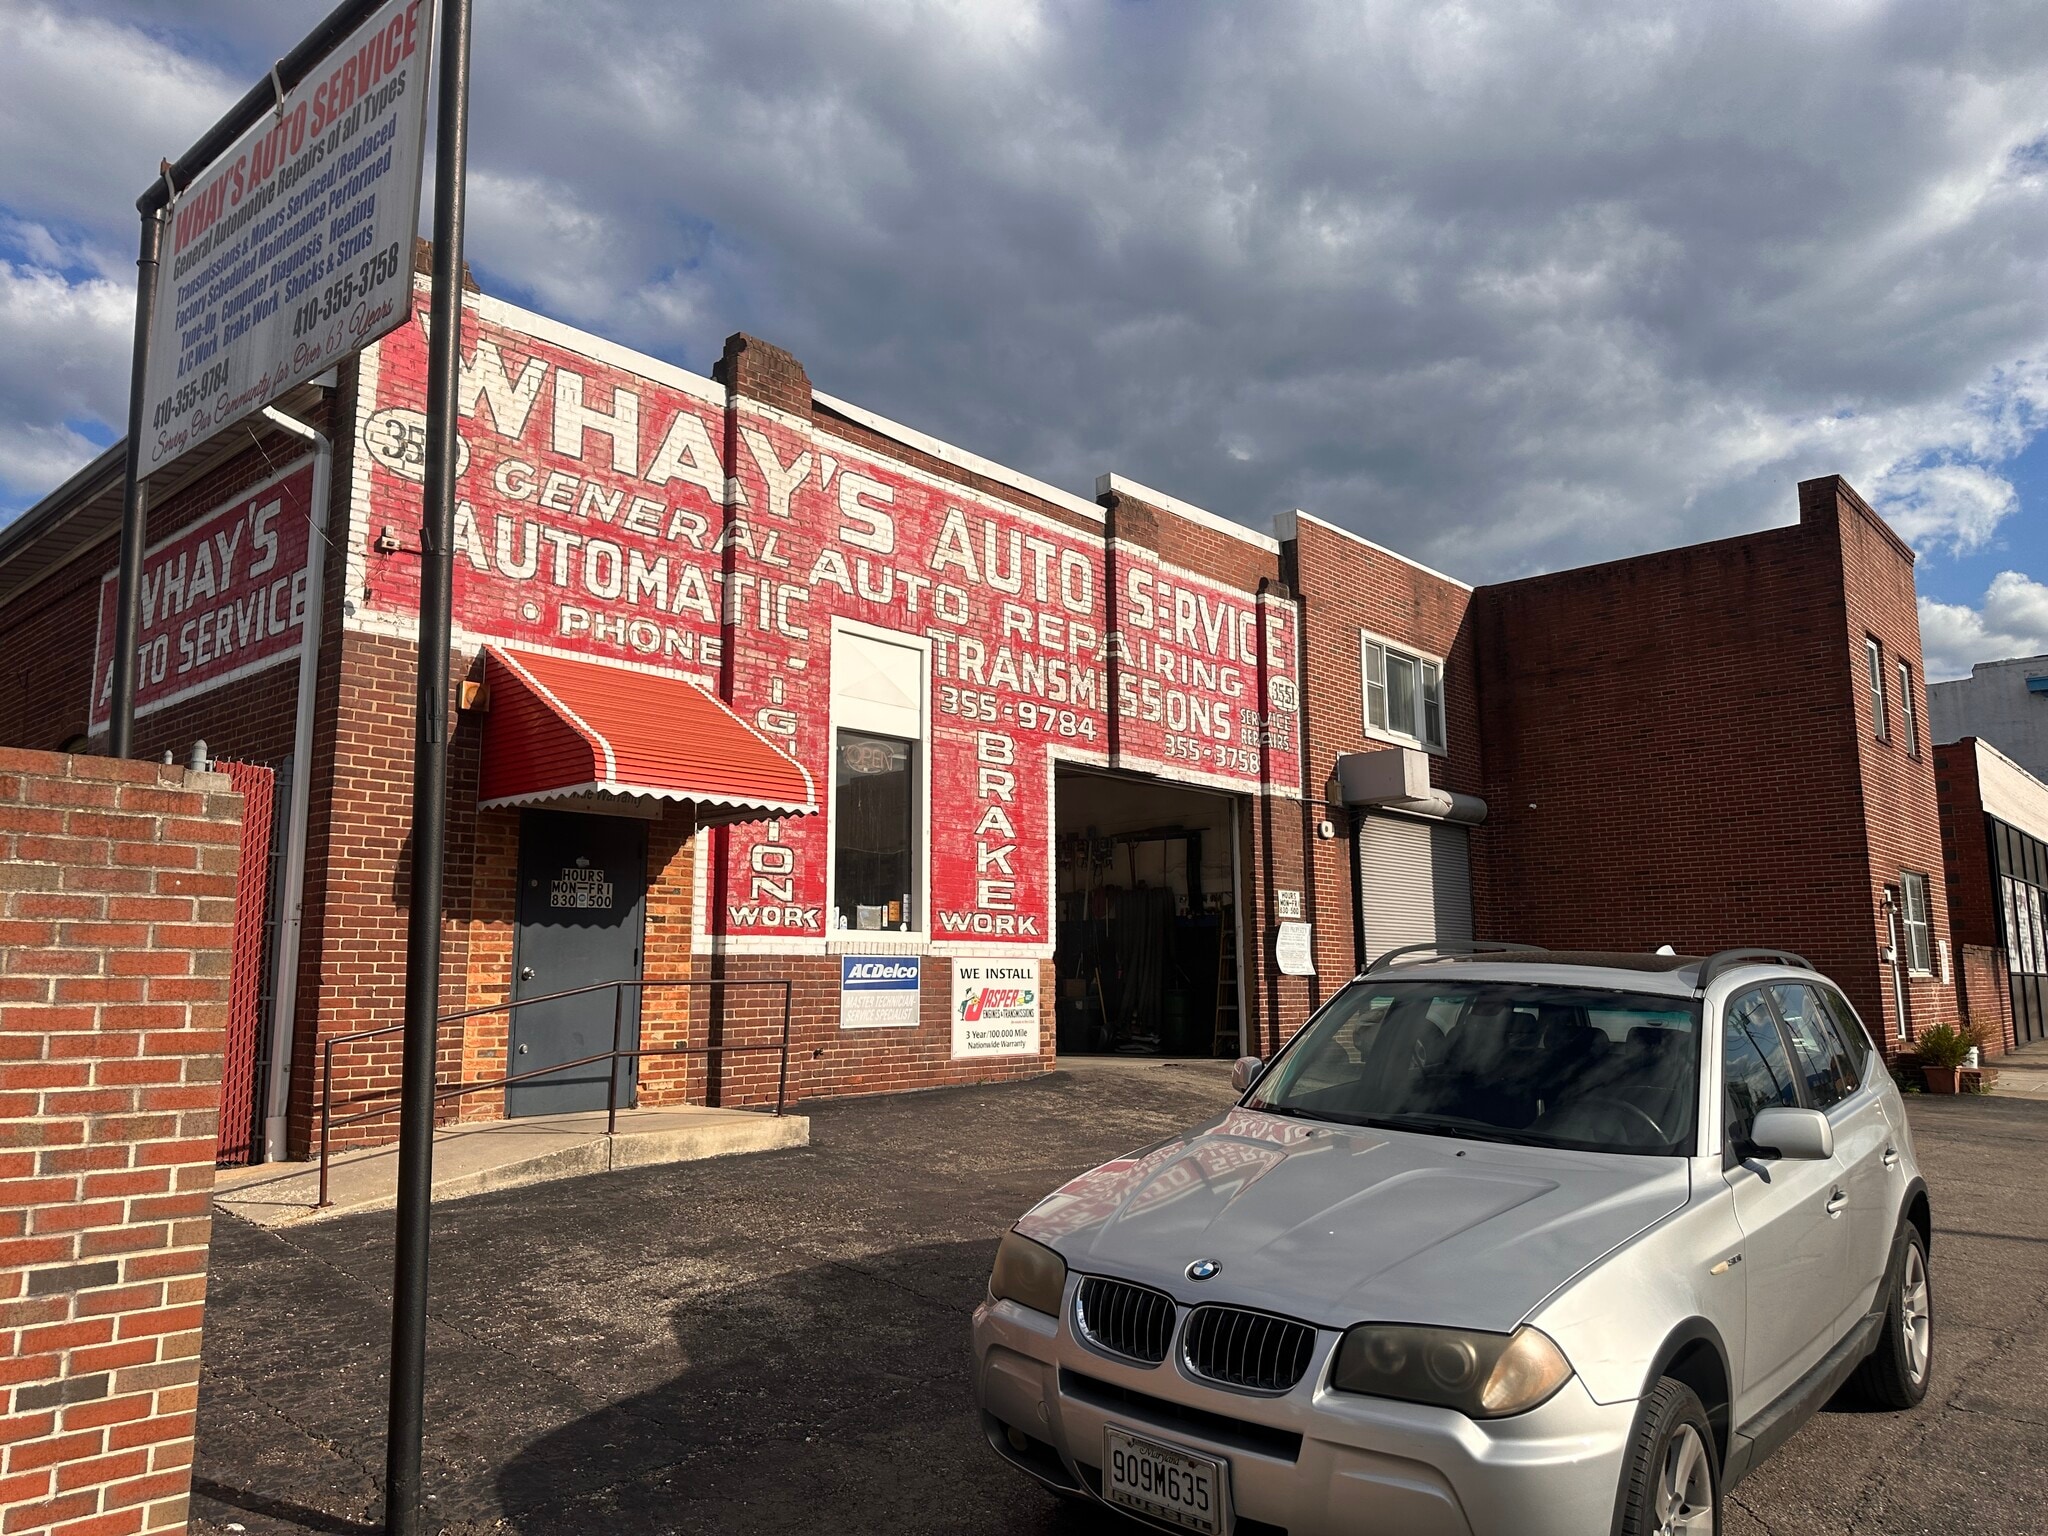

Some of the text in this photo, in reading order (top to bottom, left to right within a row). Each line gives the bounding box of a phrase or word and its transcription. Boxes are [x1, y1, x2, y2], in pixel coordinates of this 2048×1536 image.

[174, 1, 419, 256] WHAY'S AUTO SERVICE
[173, 70, 406, 281] General Automotive Repairs of all Types
[177, 112, 397, 306] Transmissions & Motors Serviced/Replaced
[175, 145, 392, 331] Factory Scheduled Maintenance Performed
[181, 193, 375, 352] Tune-Up Computer Diagnosis Heating
[177, 224, 373, 379] A/C Work Brake Work Shocks & Struts
[293, 241, 399, 338] 410-355-3758
[191, 409, 211, 437] Our
[215, 371, 271, 424] Community
[271, 361, 289, 398] for
[293, 342, 322, 374] Over
[326, 319, 344, 354] 63
[348, 298, 393, 350] Years
[153, 357, 229, 430] 410-355-9784
[417, 309, 1285, 670] WHAY'S AUTO SERVICE
[453, 499, 810, 641] AUTOMATIC
[494, 458, 1244, 698] GENERAL AUTO REPAIRING
[177, 567, 308, 675] SERVICE
[561, 603, 1261, 774] PHONE 355-9784 355-3758
[1272, 682, 1296, 706] 3551
[1240, 708, 1291, 731] SERVICE
[1241, 728, 1290, 751] REPAIRS
[847, 744, 893, 771] OPEN
[974, 730, 1018, 911] BRAKE
[562, 869, 604, 881] HOURS
[551, 894, 612, 908] 830 500
[1281, 891, 1297, 900] HOURS
[729, 905, 822, 929] WORK
[939, 910, 1039, 936] WORK
[847, 963, 918, 979] ACDelco
[960, 968, 1034, 979] WE INSTALL
[845, 996, 875, 1009] MASTER
[845, 1008, 913, 1022] SERVICE SPECIALIST
[965, 988, 1020, 1021] JASPER
[966, 1031, 971, 1039] 3
[1014, 1029, 1028, 1037] Mile
[967, 1040, 1026, 1050] Nationwide Warranty
[1139, 1447, 1180, 1466] Maryland
[1113, 1450, 1209, 1511] 909M635
